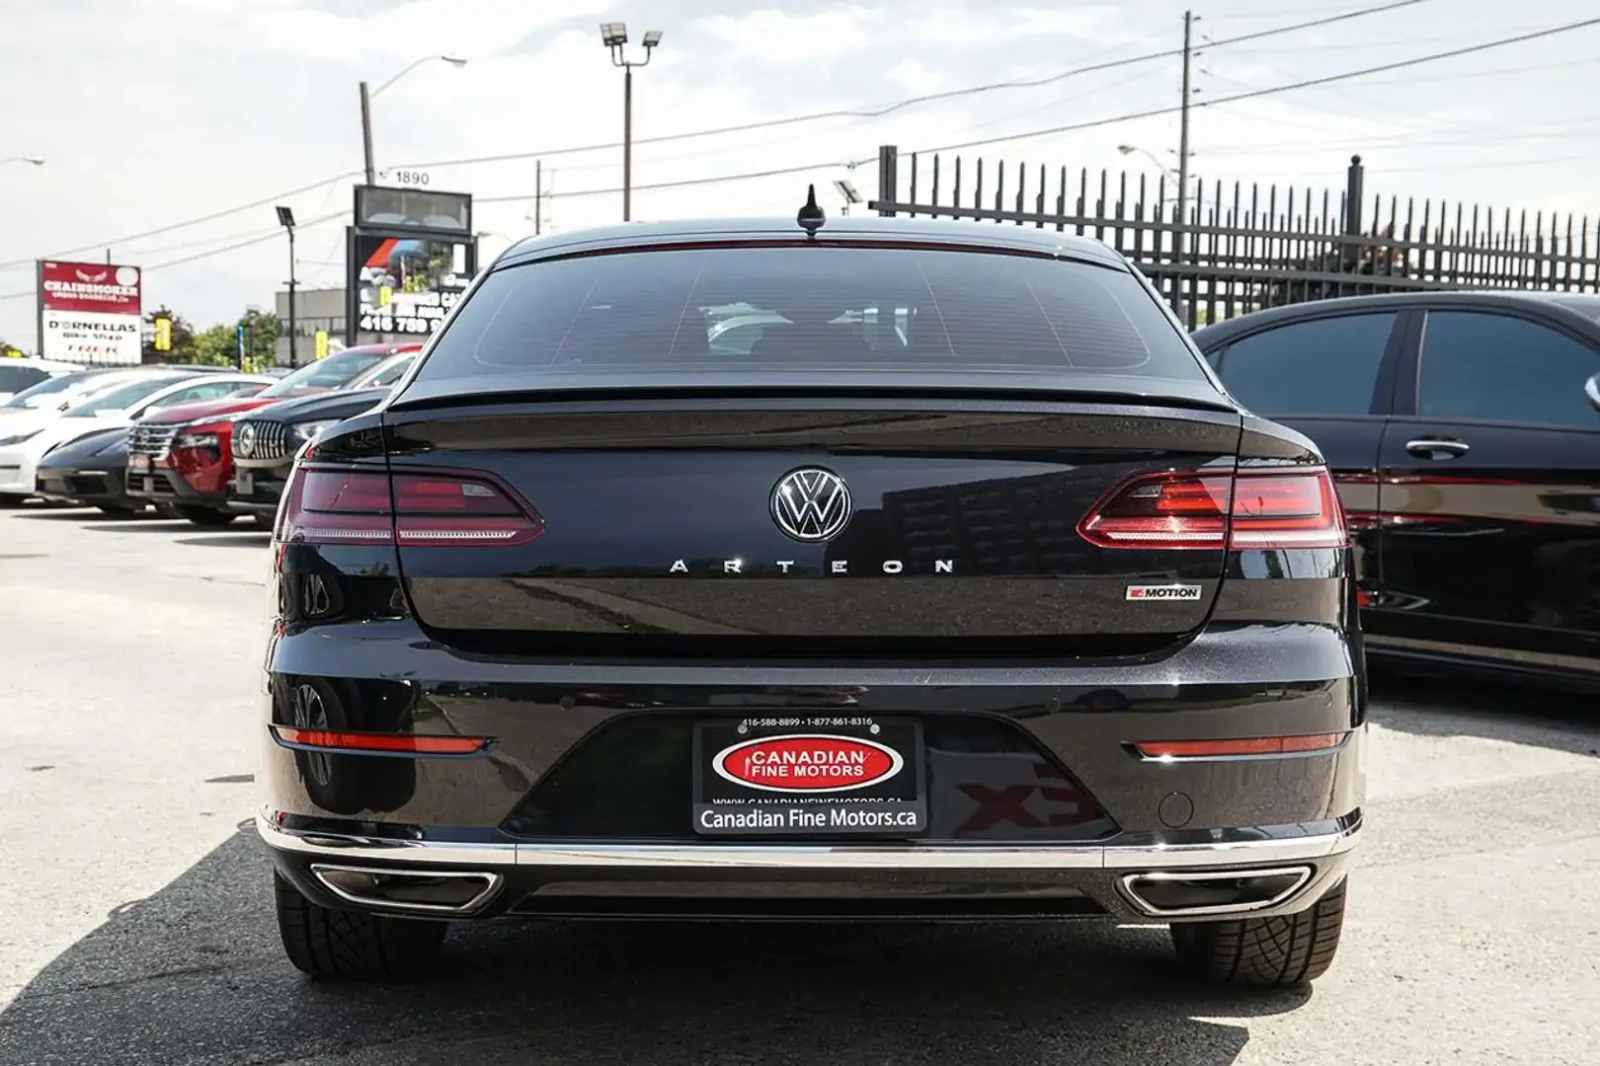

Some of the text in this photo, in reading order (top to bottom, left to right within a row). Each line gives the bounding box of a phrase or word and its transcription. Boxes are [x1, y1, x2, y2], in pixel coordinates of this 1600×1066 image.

[396, 171, 430, 185] 1890
[360, 316, 393, 332] 416
[669, 558, 954, 574] ARTEON
[741, 717, 873, 728] 416-588-8899 1-877-861-8316
[751, 750, 865, 765] CANADIAN
[751, 765, 865, 777] FINE MOTORS
[700, 807, 917, 828] Canadian Fine Motors.ca
